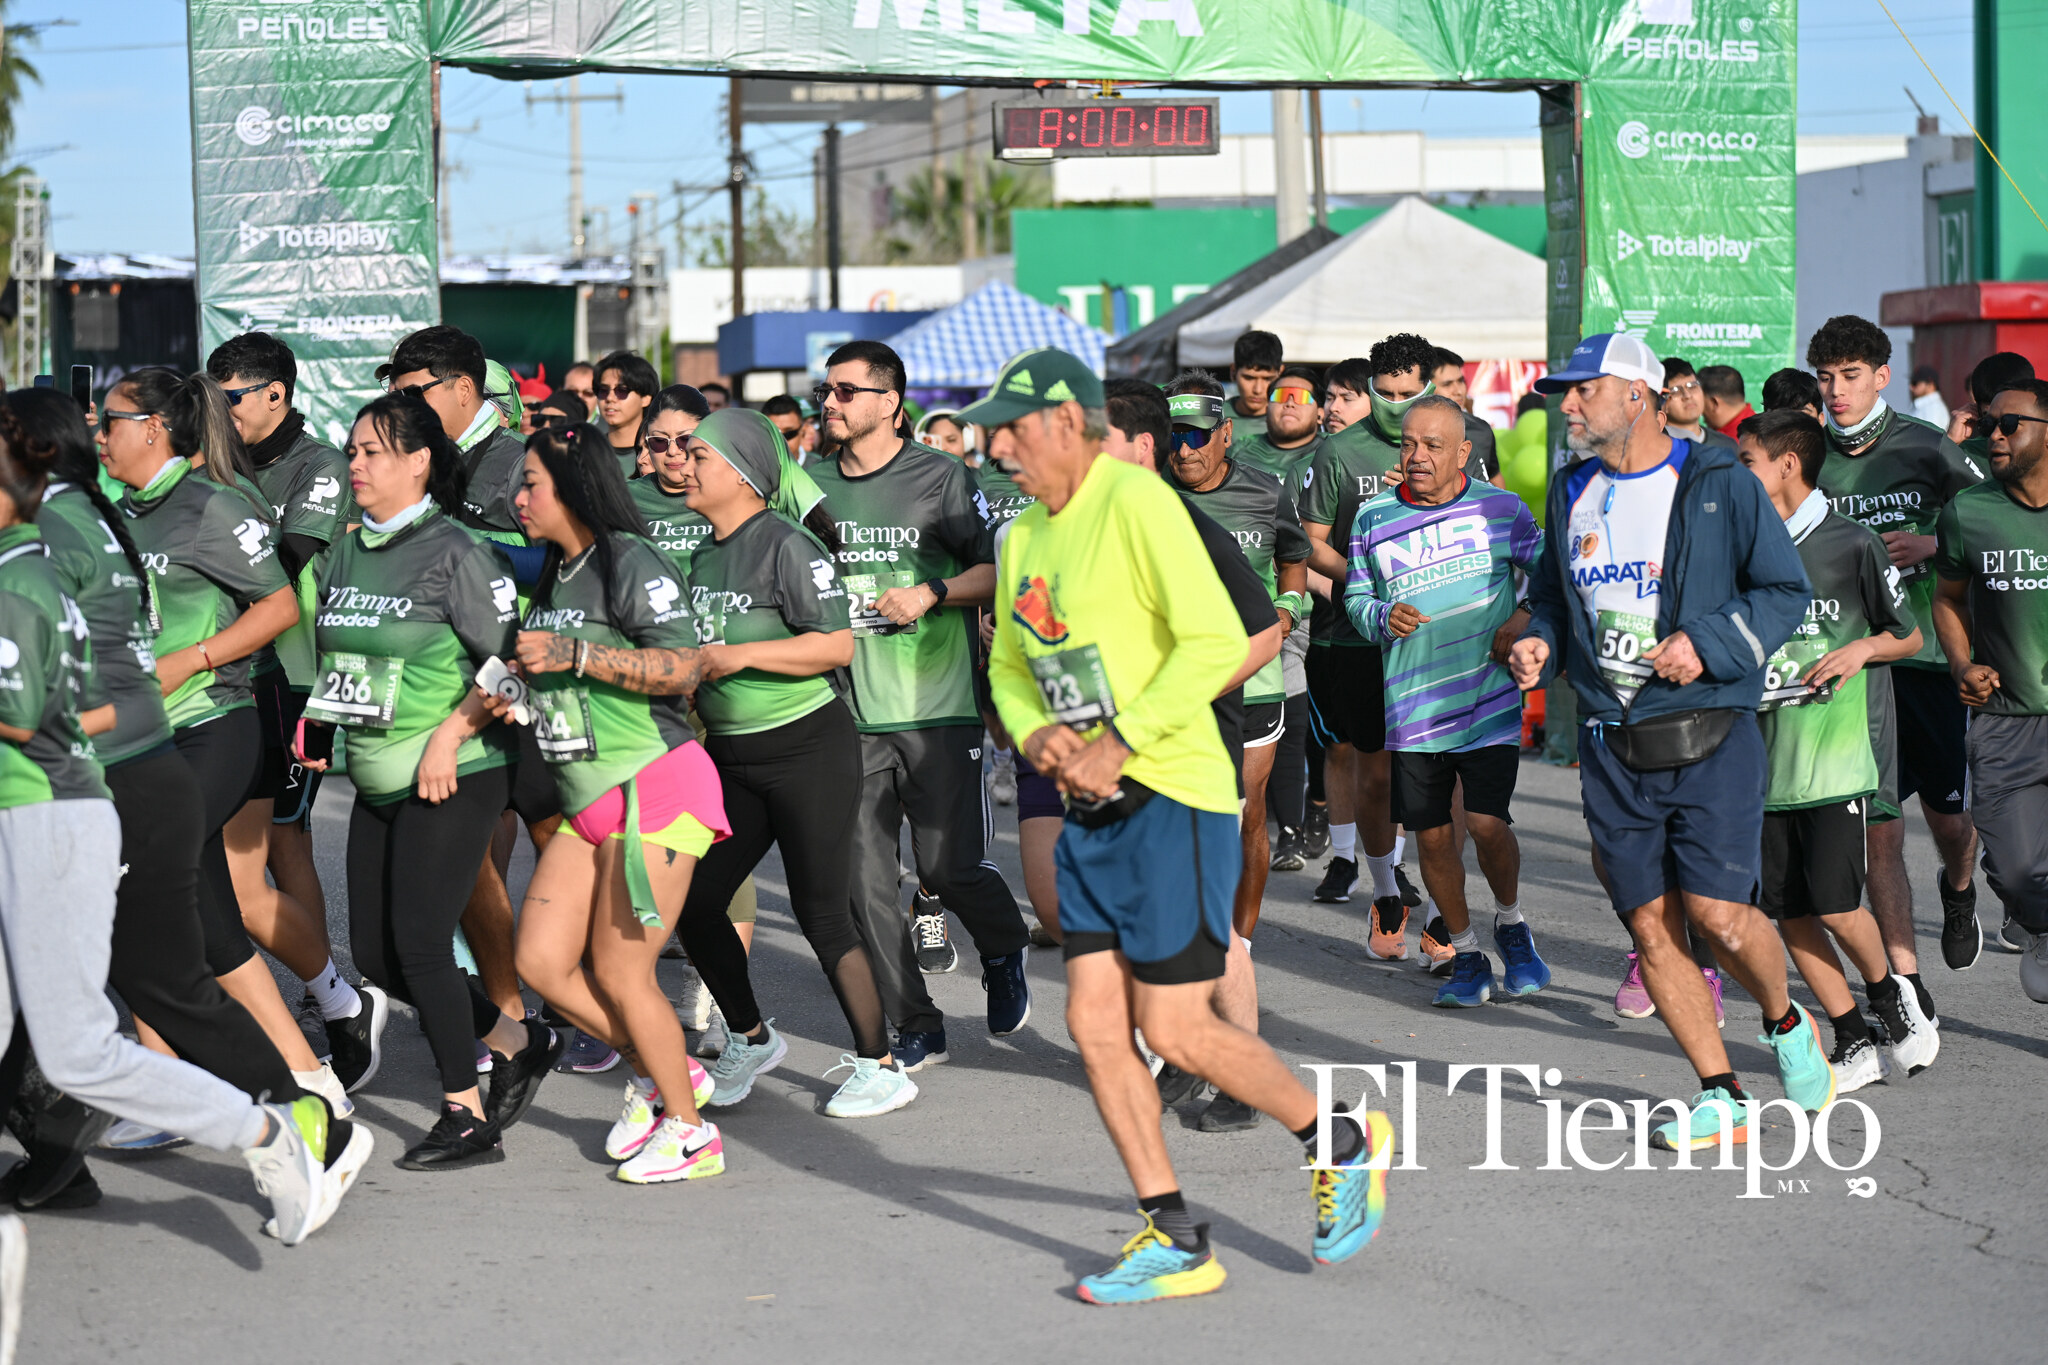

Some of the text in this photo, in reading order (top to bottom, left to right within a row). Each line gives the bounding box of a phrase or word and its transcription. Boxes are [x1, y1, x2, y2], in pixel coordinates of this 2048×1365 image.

[237, 13, 389, 43] PEÑOLES
[1622, 34, 1760, 62] PEÑOLES
[1653, 131, 1758, 150] cimaco
[273, 223, 390, 251] Totalplay
[1647, 234, 1752, 263] Totalplay
[297, 313, 404, 333] FRONTERA
[1665, 323, 1763, 339] FRONTERA
[1842, 491, 1921, 516] Tiempo
[835, 521, 920, 549] Tiempo
[840, 548, 900, 563] todos
[1981, 549, 2048, 574] El Tie
[1386, 553, 1492, 596] RUNNERS
[1407, 585, 1431, 598] NORA
[1431, 575, 1463, 591] LETICIA
[1463, 567, 1493, 580] ROCHA
[1986, 577, 2010, 591] de
[334, 587, 413, 616] Tiempo
[323, 612, 381, 628] todos
[322, 671, 372, 704] 266
[382, 674, 398, 722] MEDALLA
